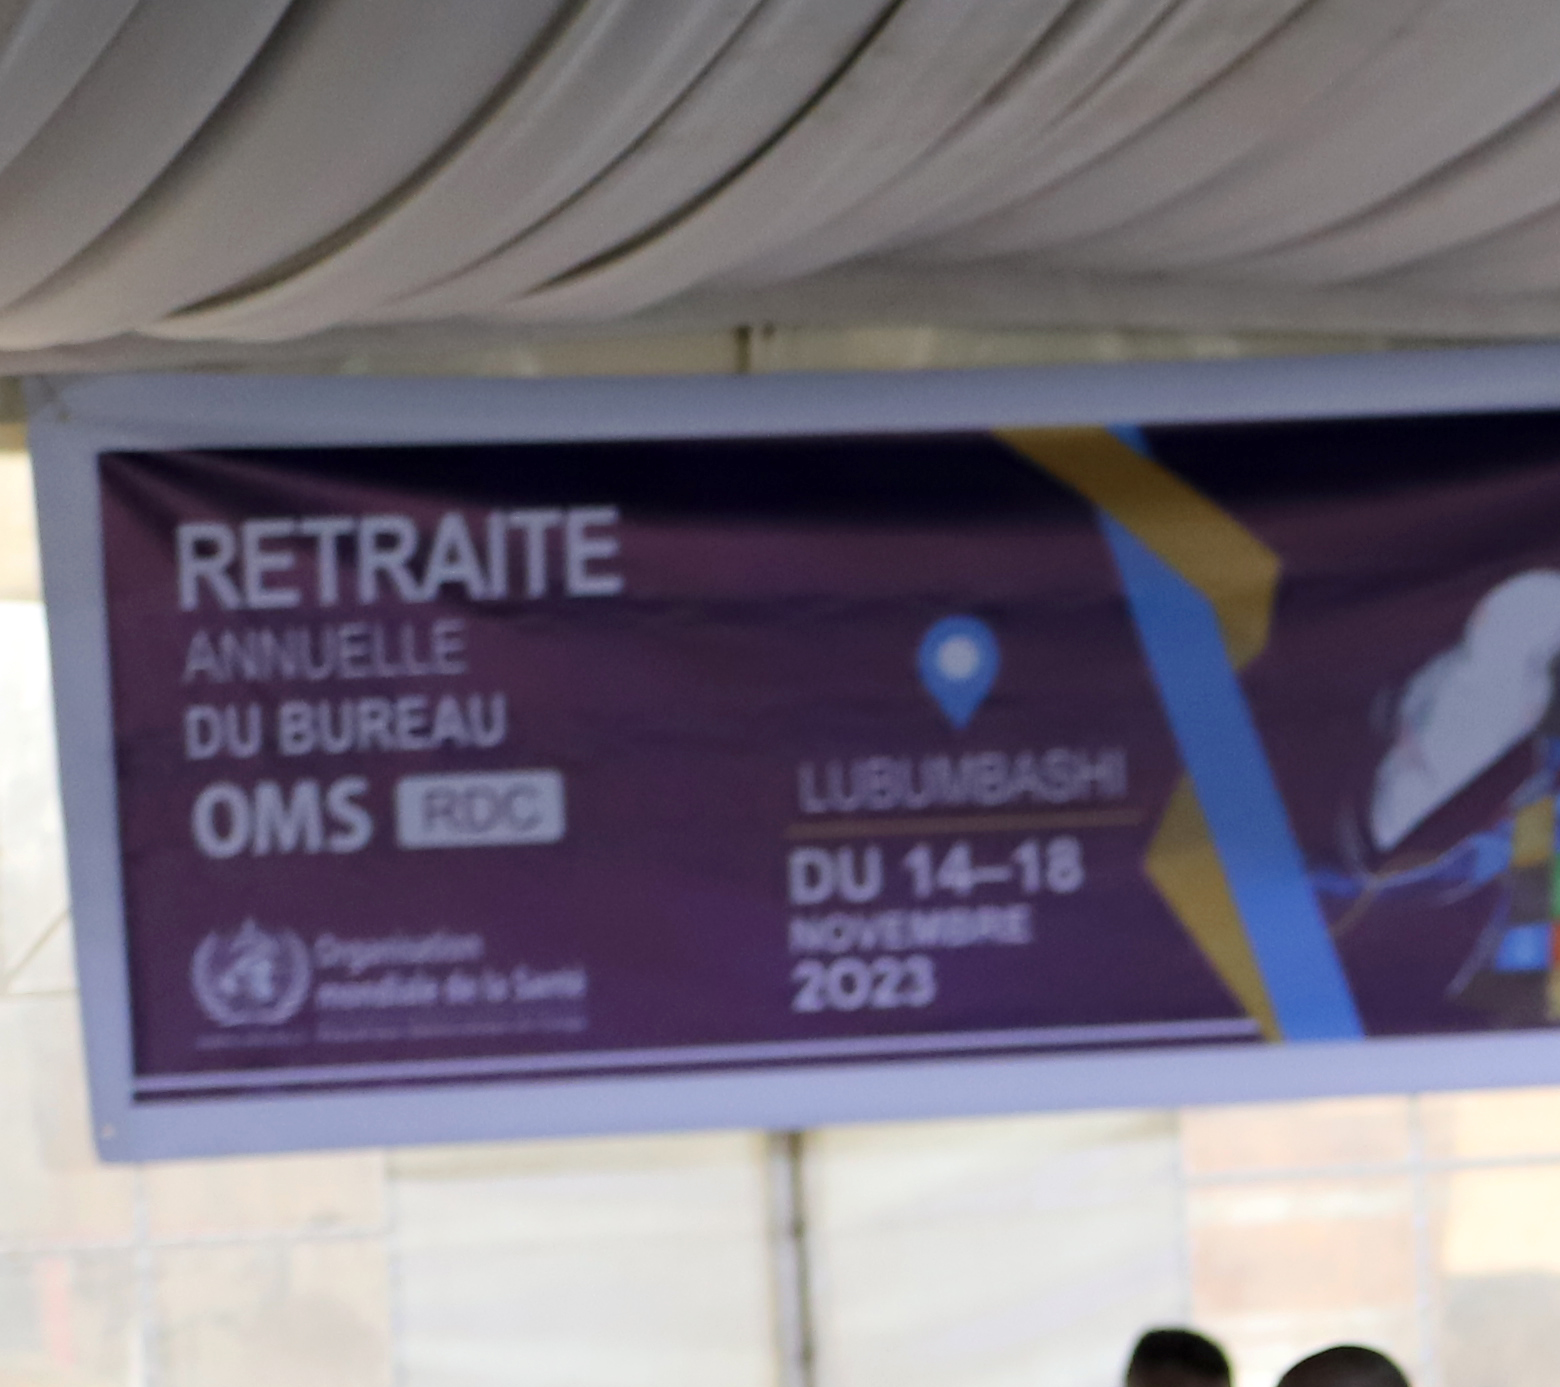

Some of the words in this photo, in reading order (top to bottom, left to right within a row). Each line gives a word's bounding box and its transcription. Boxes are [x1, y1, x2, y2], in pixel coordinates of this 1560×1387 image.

[177, 506, 624, 612] RETRAITE
[182, 617, 468, 685] ANNUELLE
[185, 702, 262, 762] DU
[278, 694, 507, 758] BUREAU
[798, 747, 1127, 814] LUBUMBASHI
[192, 775, 374, 859] OMS
[421, 785, 545, 836] RDC
[788, 845, 884, 905] DU
[789, 903, 1033, 953] NOVEMBRE
[791, 954, 938, 1014] 2023
